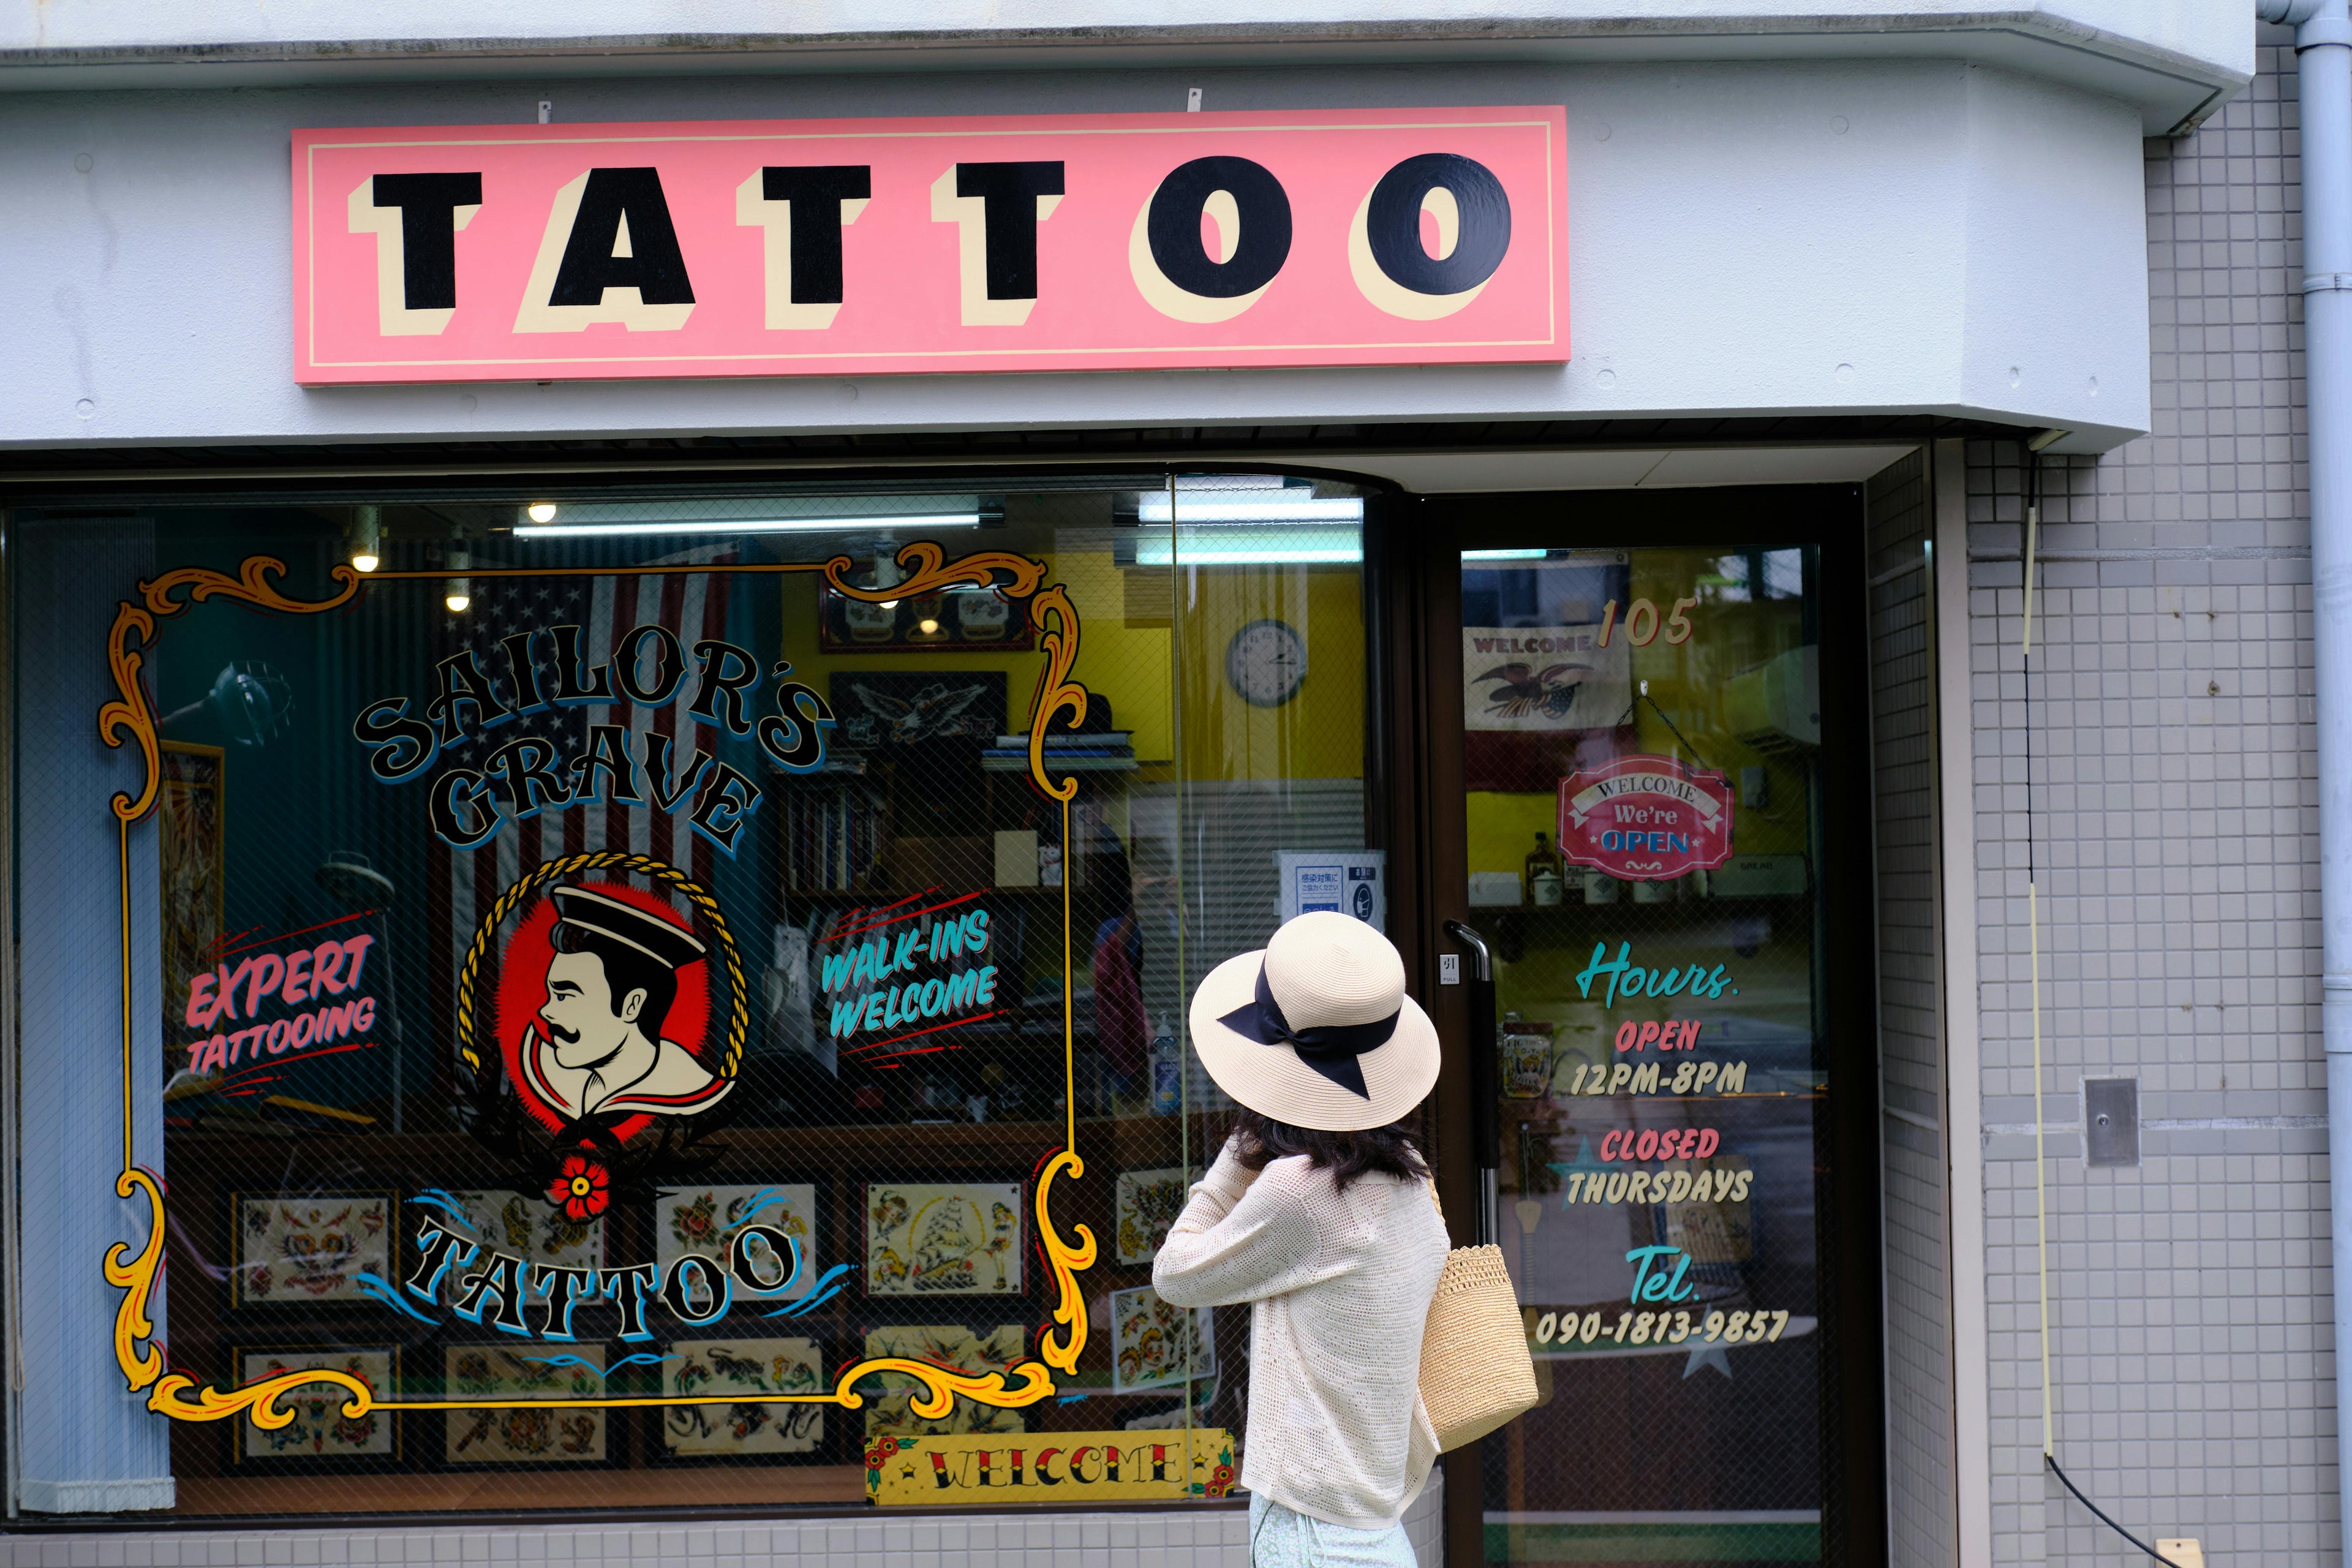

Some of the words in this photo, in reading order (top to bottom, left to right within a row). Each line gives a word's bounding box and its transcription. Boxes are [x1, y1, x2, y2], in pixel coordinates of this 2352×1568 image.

[348, 152, 1512, 336] TATTOO
[1474, 635, 1591, 654] WELCOME
[1597, 597, 1698, 648] 105
[353, 624, 838, 785] SAILOR'S
[429, 725, 763, 853] GRAVE
[1597, 775, 1697, 804] WELCOME
[1614, 804, 1678, 825] We're
[1601, 829, 1689, 854] OPEN
[1302, 873, 1338, 883] 感染対策に
[821, 909, 990, 993] WALK-INS
[1444, 957, 1454, 970] 引
[1575, 940, 1740, 1009] Hours.
[185, 933, 375, 1031] EXPERT
[830, 965, 998, 1039] WELCOME
[187, 997, 376, 1075] TATTOOING
[1615, 1019, 1702, 1052] OPEN
[1570, 1060, 1748, 1095] 12PM-8PM
[1599, 1127, 1720, 1162] CLOSED
[1567, 1168, 1754, 1205] THURSDAYS
[406, 1215, 800, 1342] TATTOO
[1625, 1245, 1700, 1305] Tel.
[1535, 1310, 1790, 1344] 090-1813-9857
[924, 1442, 1183, 1490] WELCOME
